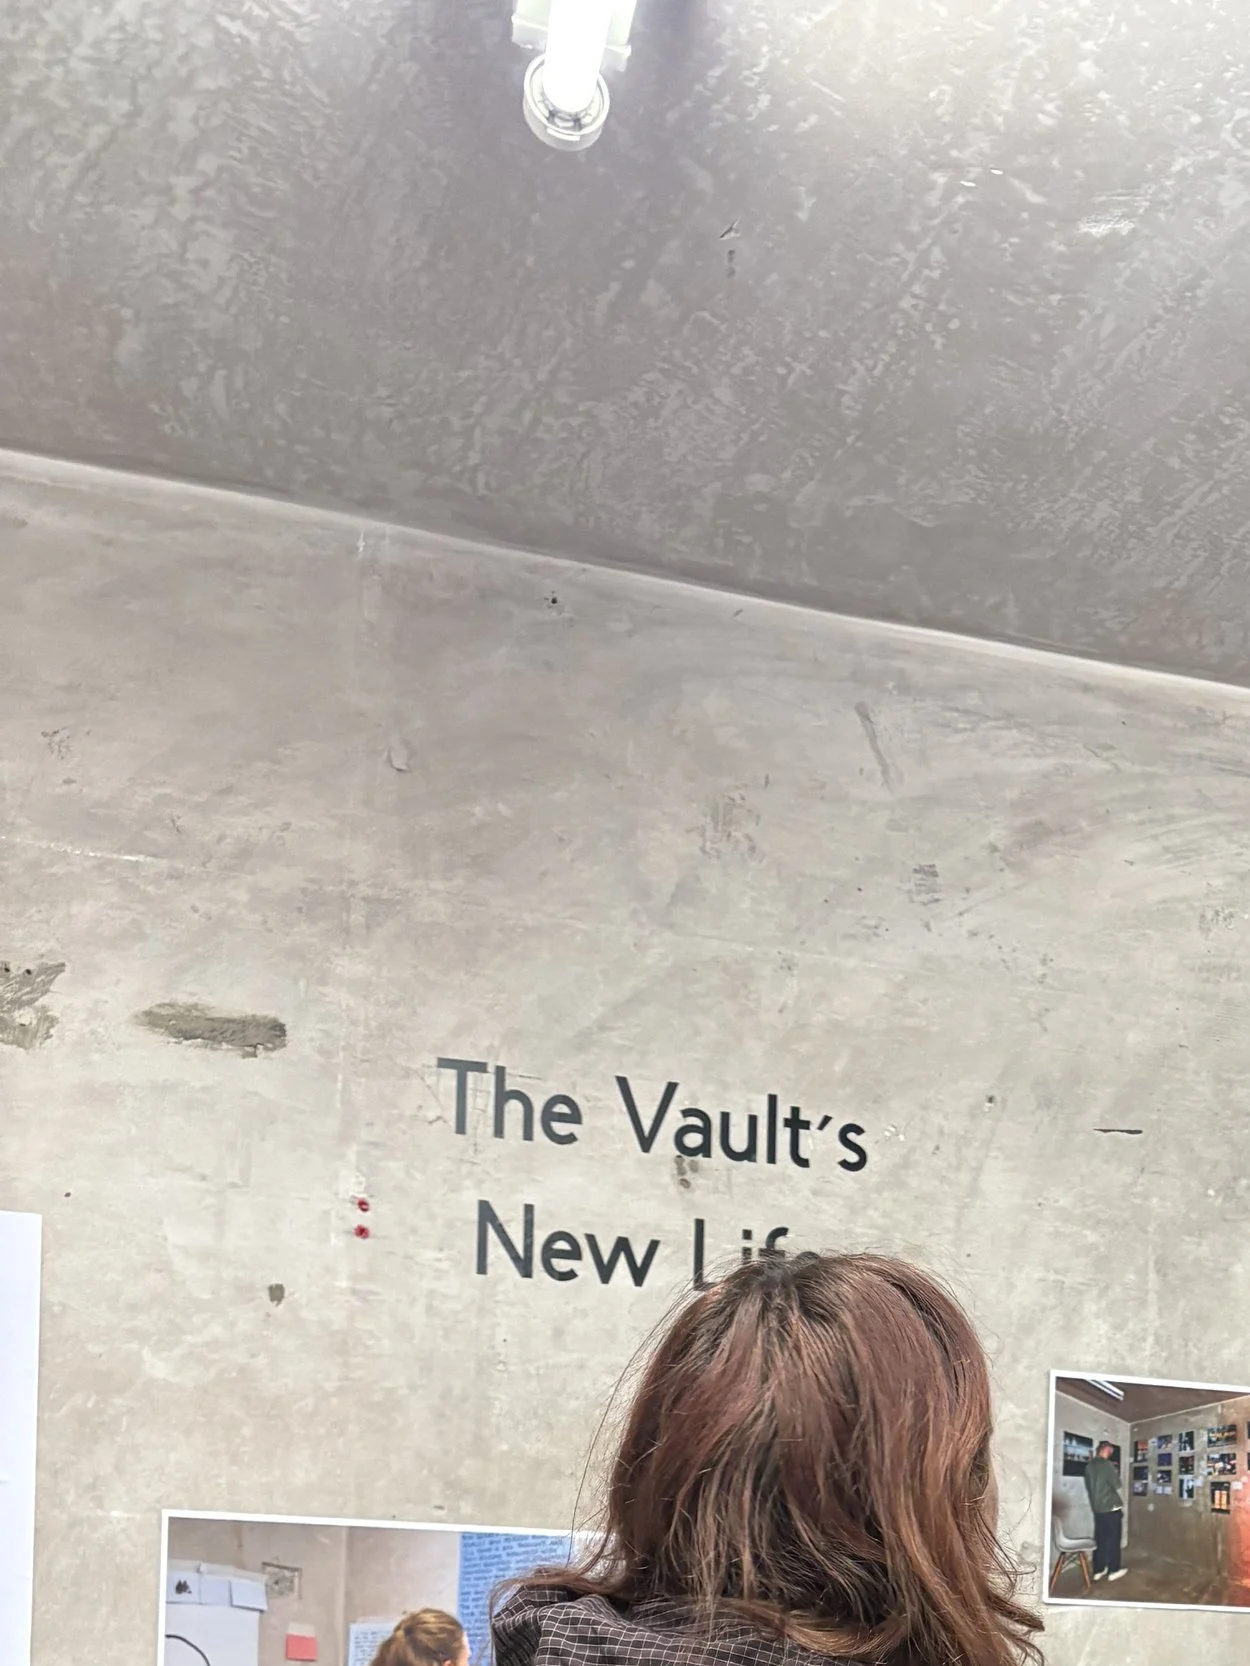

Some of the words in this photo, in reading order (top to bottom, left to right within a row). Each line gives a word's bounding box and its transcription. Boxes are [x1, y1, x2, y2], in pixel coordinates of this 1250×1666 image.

[437, 1056, 583, 1146] The
[614, 1074, 869, 1173] Vault's
[475, 1199, 661, 1288] New
[692, 1217, 822, 1292] Lif
